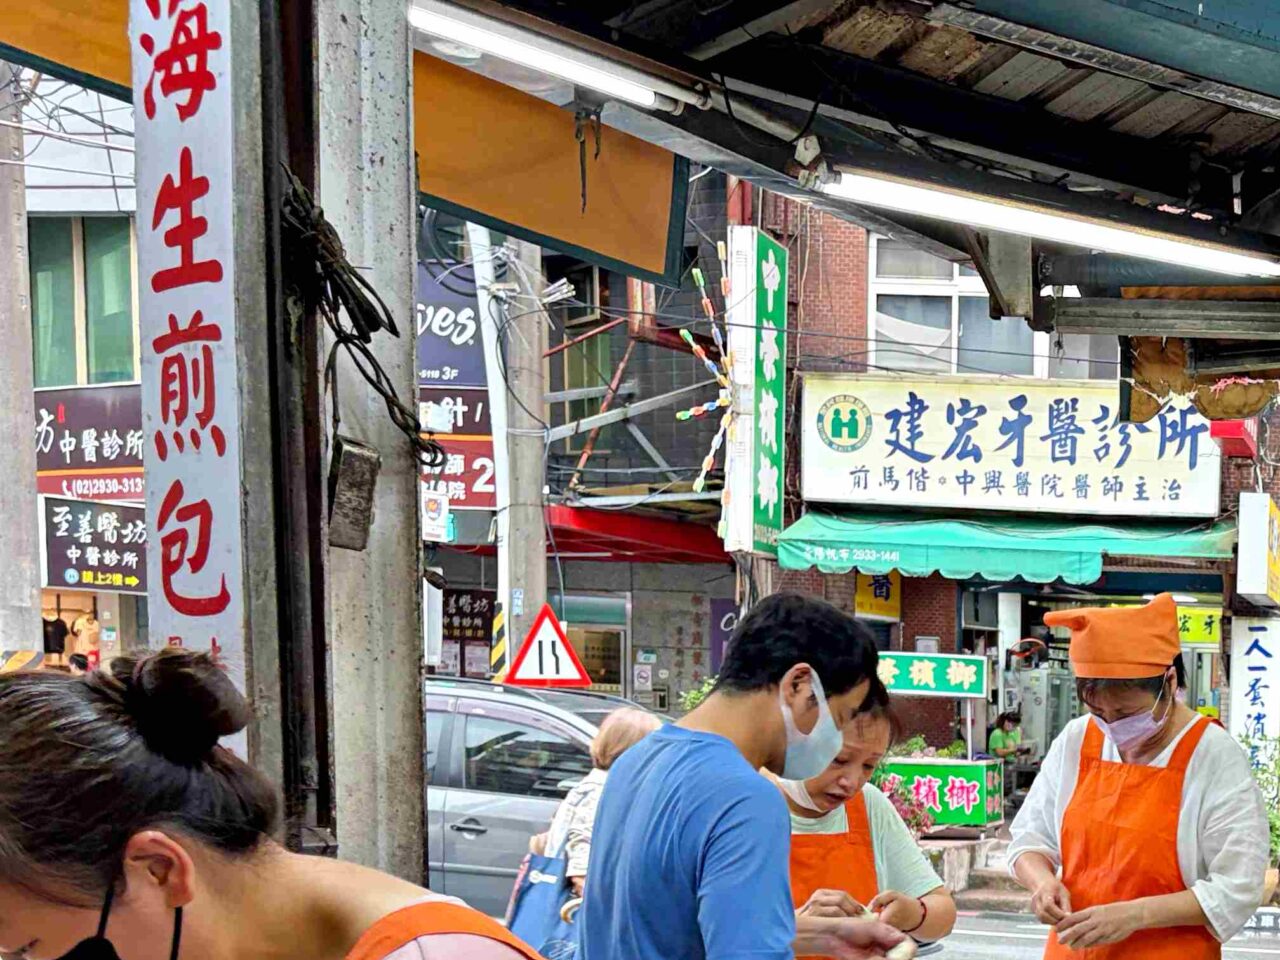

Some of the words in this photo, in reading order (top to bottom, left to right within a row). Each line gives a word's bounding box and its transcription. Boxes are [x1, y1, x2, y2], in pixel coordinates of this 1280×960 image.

[442, 366, 459, 380] 3F
[59, 427, 143, 464] 中醫診所
[884, 392, 1209, 471] 建宏牙醫診所
[53, 506, 147, 544] 至善醫坊
[66, 545, 138, 569] 中醫診所
